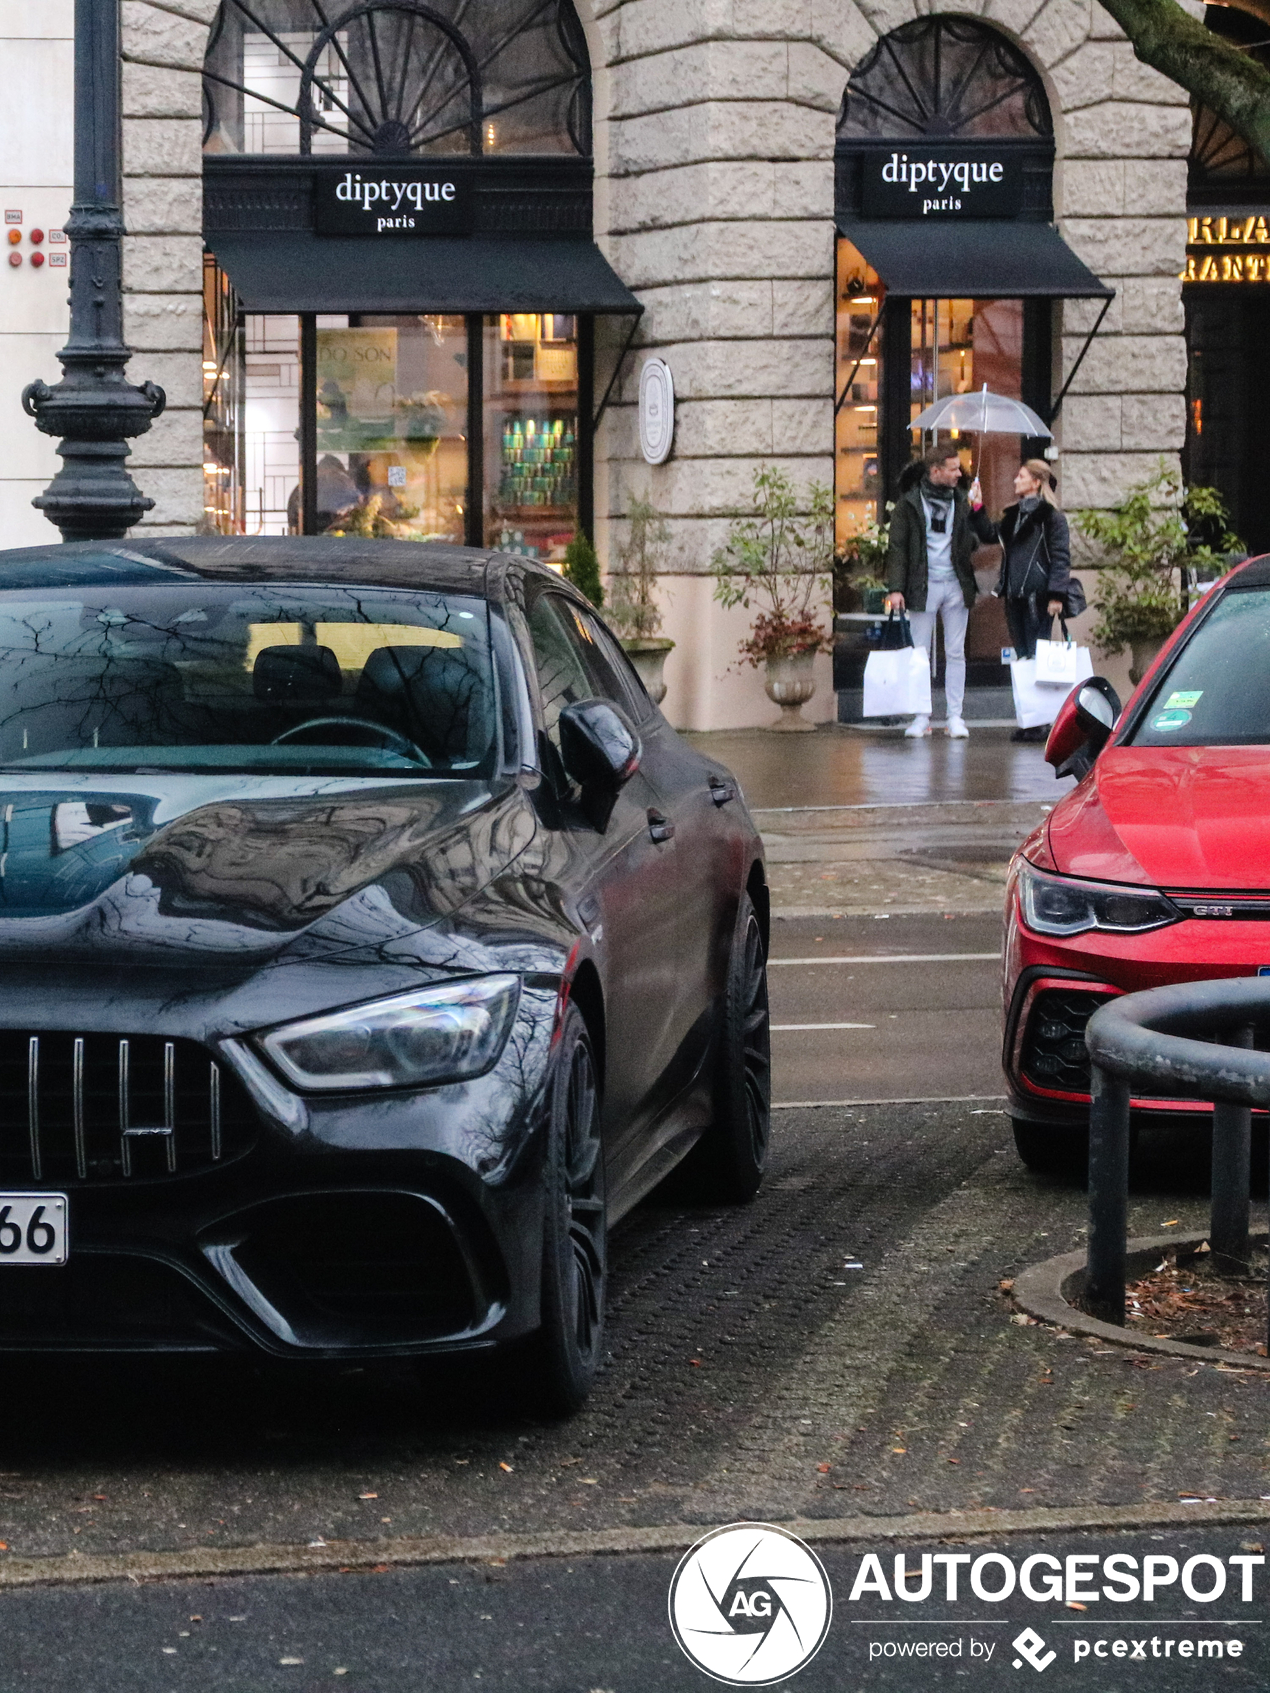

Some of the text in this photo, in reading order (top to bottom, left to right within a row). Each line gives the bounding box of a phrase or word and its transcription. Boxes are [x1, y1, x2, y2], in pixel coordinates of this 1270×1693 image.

[881, 153, 1004, 192] diptyque
[335, 172, 456, 211] diptyque
[922, 195, 962, 215] paris
[376, 214, 416, 233] paris
[354, 346, 391, 362] SON
[1193, 905, 1233, 916] GTI
